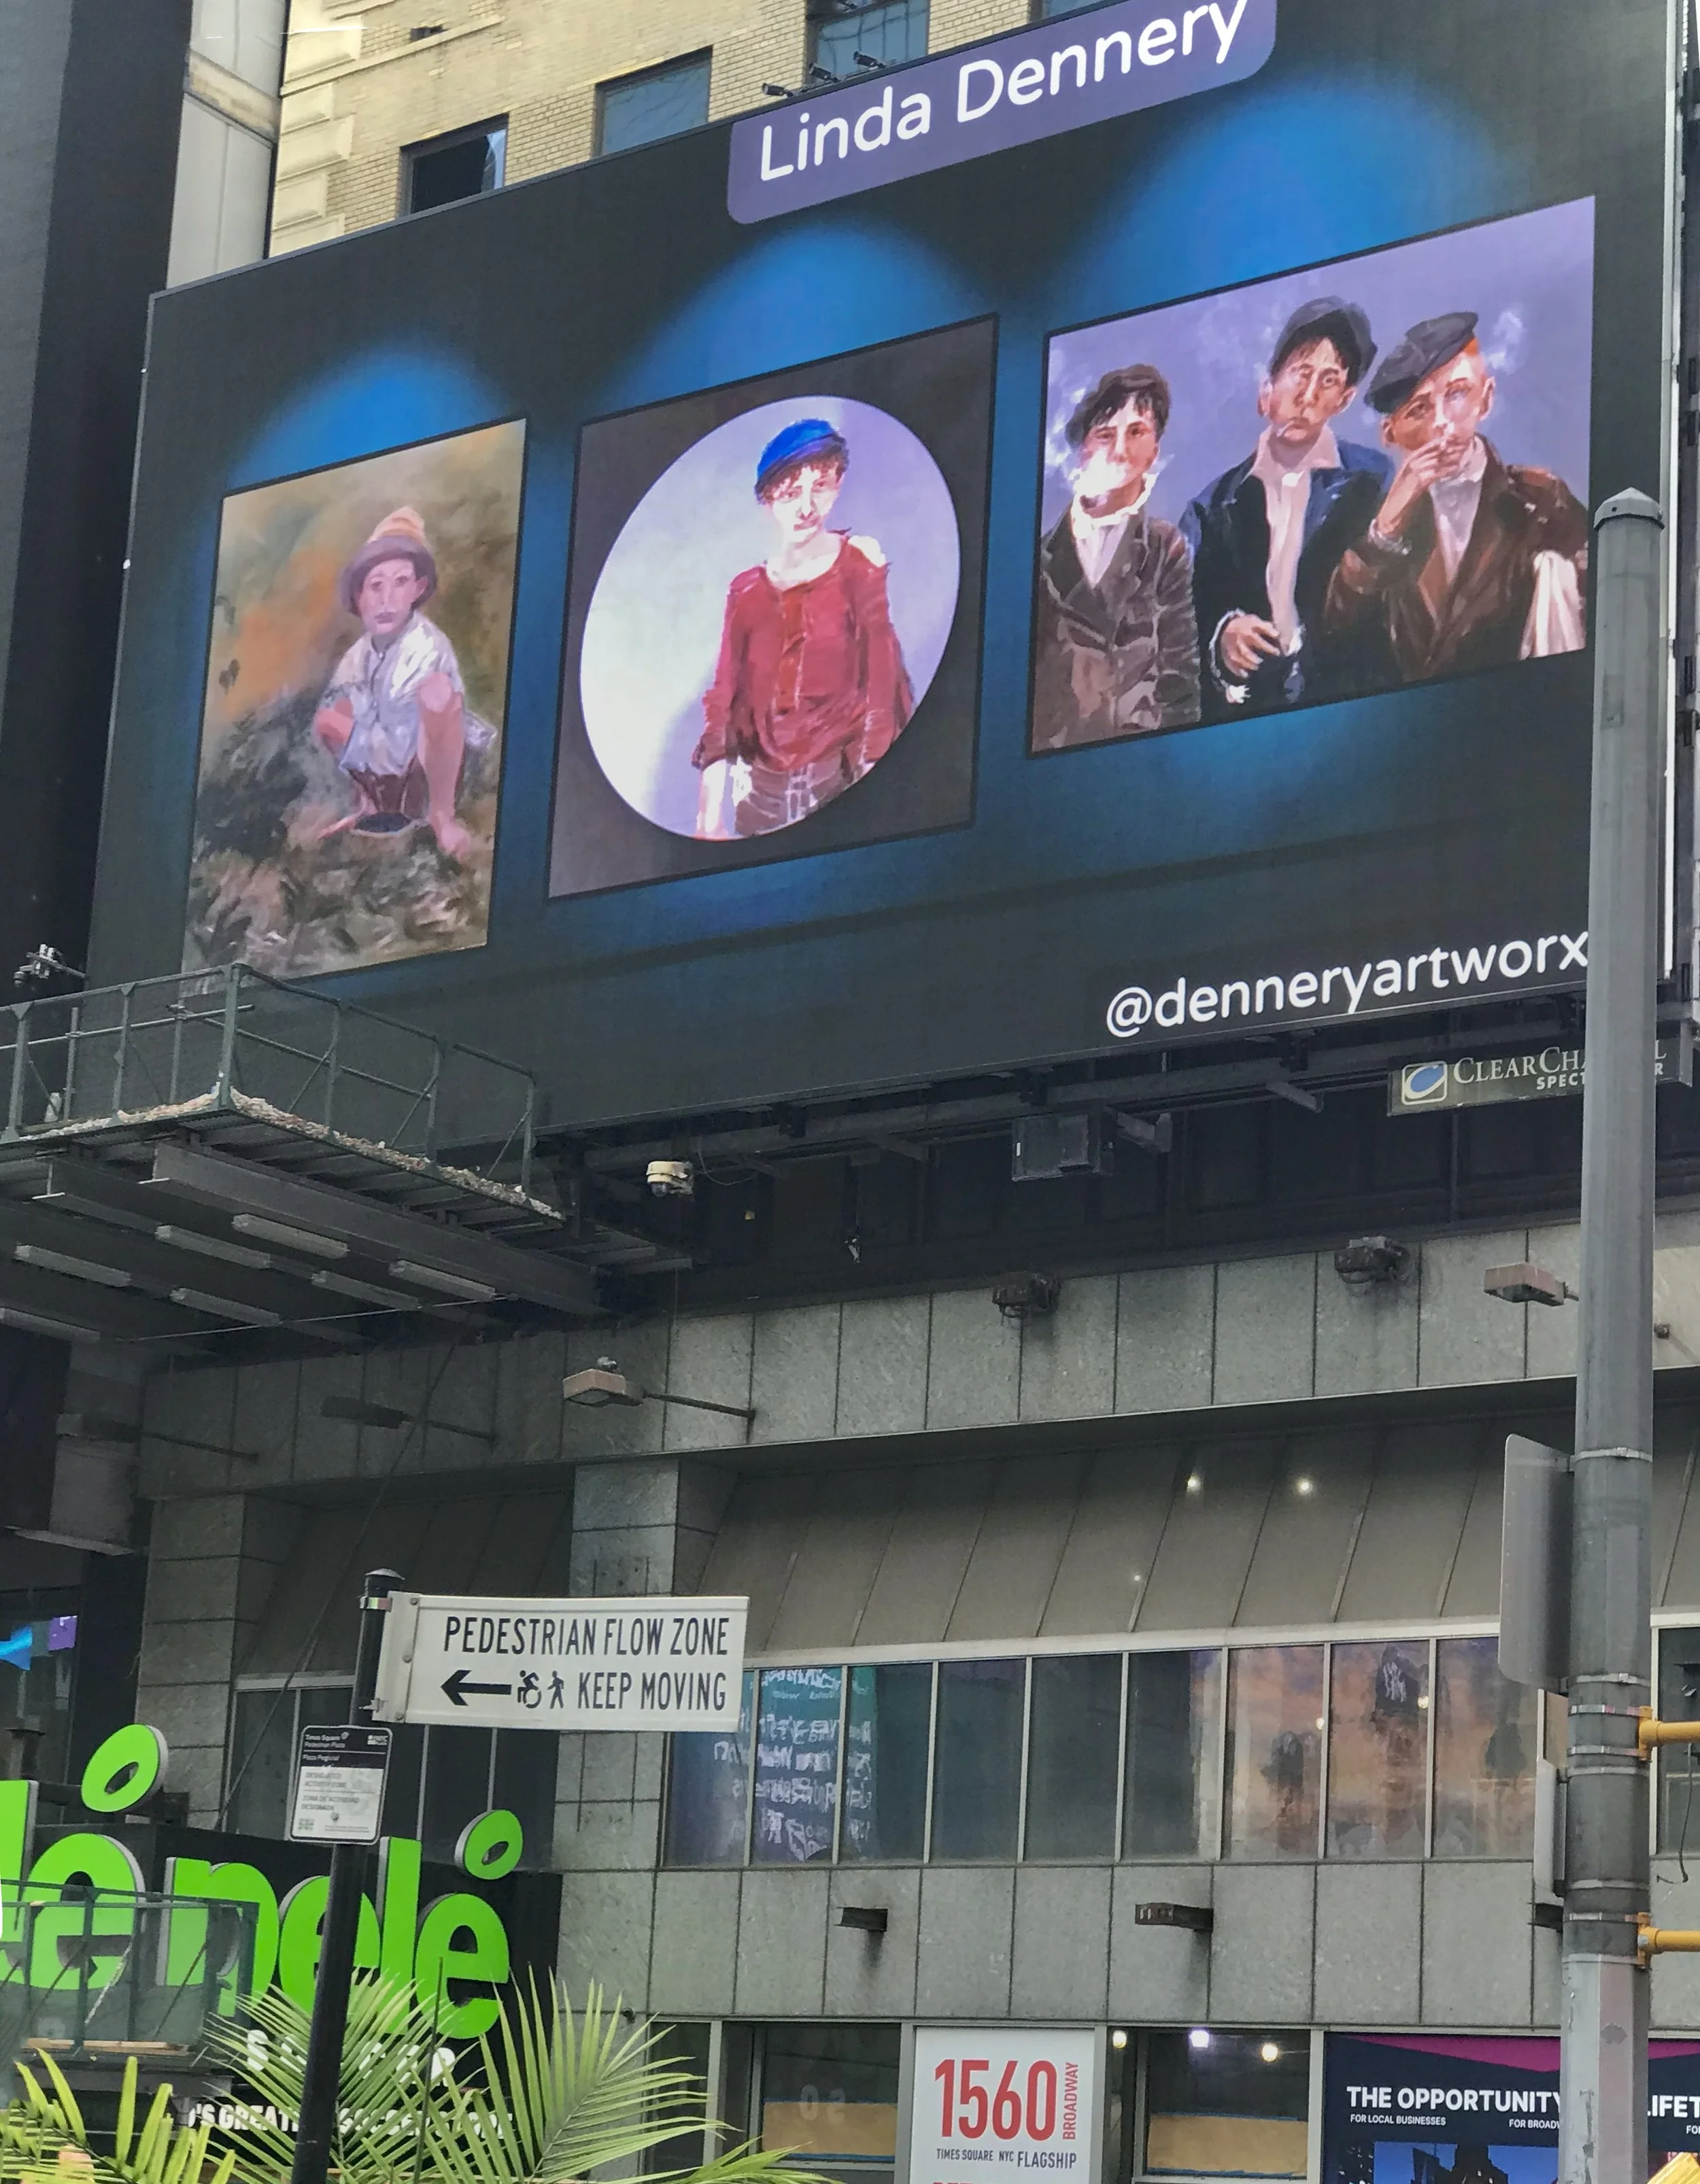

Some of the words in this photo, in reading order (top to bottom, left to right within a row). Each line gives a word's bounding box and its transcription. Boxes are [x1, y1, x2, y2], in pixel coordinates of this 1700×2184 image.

[760, 86, 932, 182] Linda
[957, 0, 1248, 124] Dennery
[1106, 929, 1589, 1038] @denneryartworx
[443, 1616, 597, 1655] PEDESTRIAN
[603, 1618, 664, 1656] FLOW
[670, 1618, 730, 1655] ZONE
[577, 1671, 632, 1709] KEEP
[640, 1672, 727, 1711] MOVING
[934, 2059, 1057, 2142] 1560
[1062, 2062, 1079, 2140] BROADWAY
[1346, 2086, 1393, 2109] THE
[1350, 2113, 1367, 2123] FOR
[1368, 2114, 1395, 2124] LOCAL
[1396, 2115, 1446, 2126] BUSINESSES
[1509, 2119, 1526, 2128] FOR
[1528, 2119, 1560, 2130] BROAD
[1686, 2125, 1700, 2135] FO
[936, 2148, 960, 2160] TIMES
[962, 2149, 993, 2162] SQUARE
[999, 2150, 1015, 2162] NYC
[1017, 2151, 1077, 2169] FLAGSHIP
